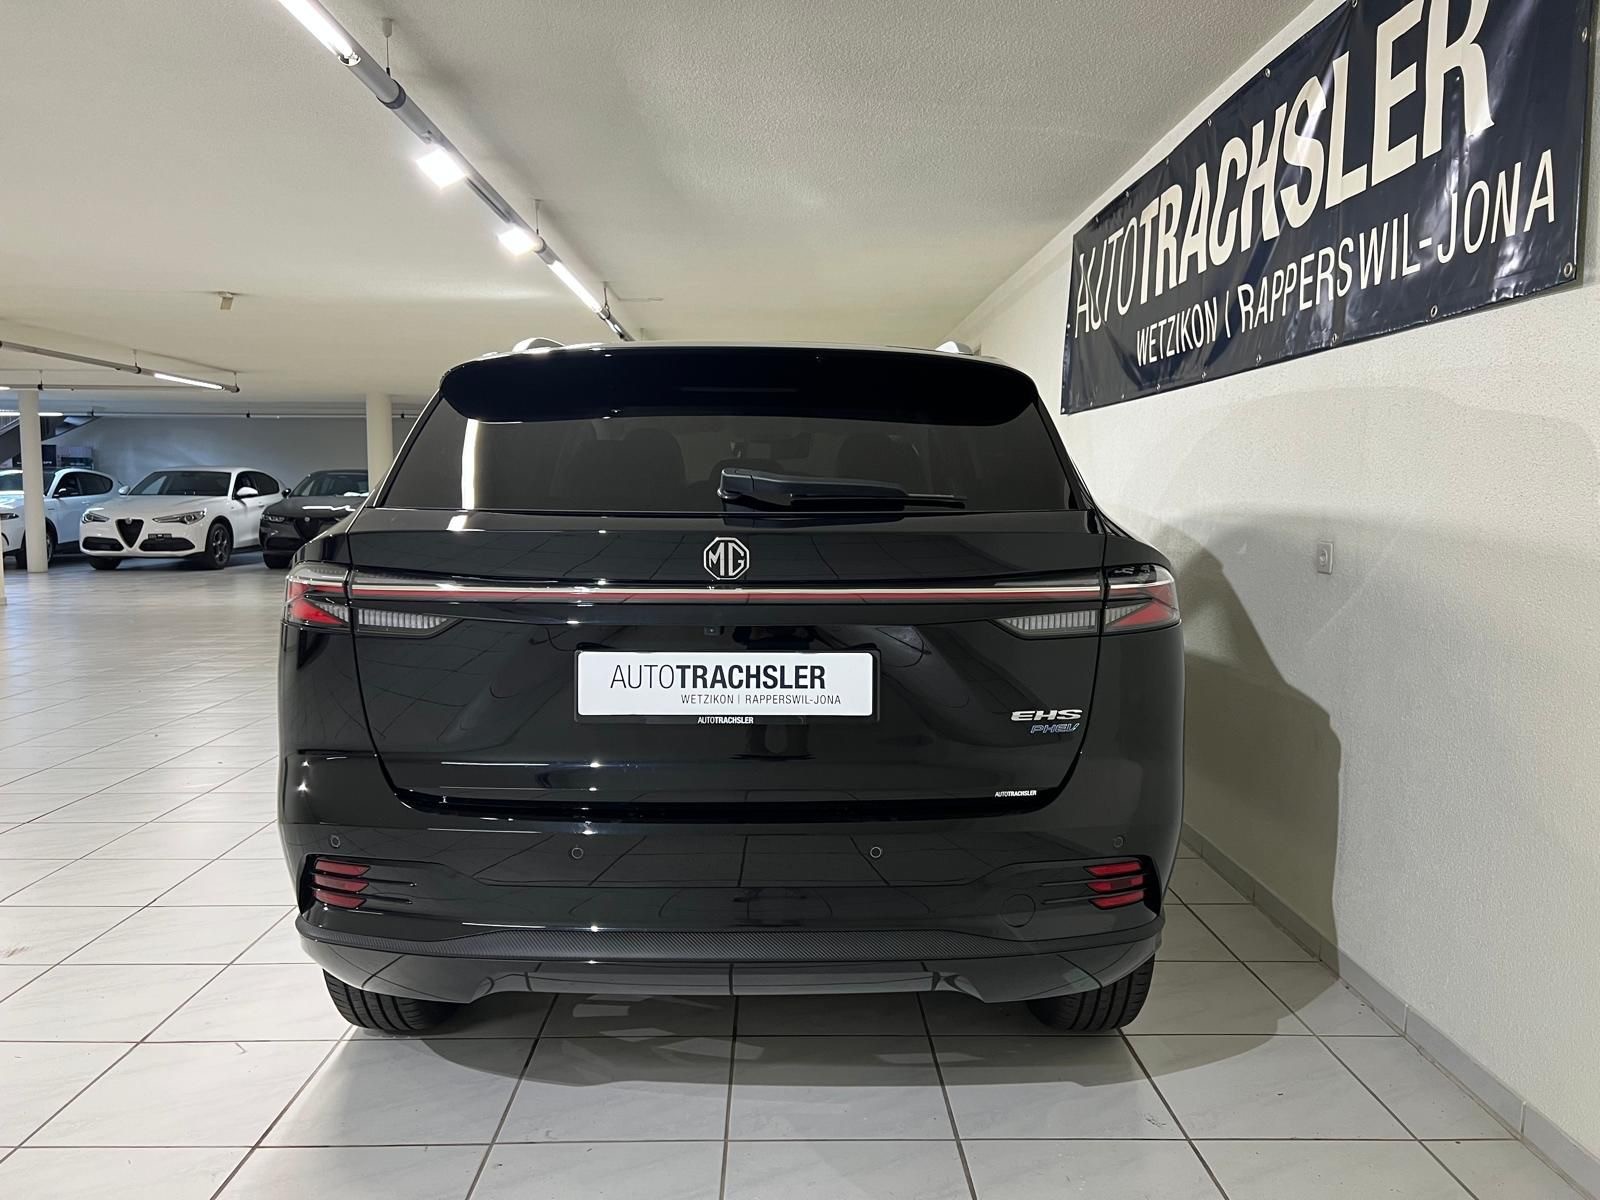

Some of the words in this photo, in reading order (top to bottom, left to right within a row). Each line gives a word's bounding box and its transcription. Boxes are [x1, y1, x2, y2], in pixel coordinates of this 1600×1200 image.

[1074, 0, 1495, 339] AUTOTRACHSLER
[1136, 296, 1218, 367] WETZIKON
[1238, 148, 1556, 333] RAPPERSWIL-JONA
[708, 541, 746, 577] MG
[610, 664, 826, 689] AUTOTRACHSLER
[681, 694, 734, 705] WETZIKON
[745, 694, 842, 705] RAPPERSWIL-JONA
[697, 716, 754, 725] AUTOTRACHSLER
[1011, 709, 1083, 721] EHS
[1030, 722, 1080, 734] PHEV
[994, 789, 1037, 798] AUTOTRACHSLER
